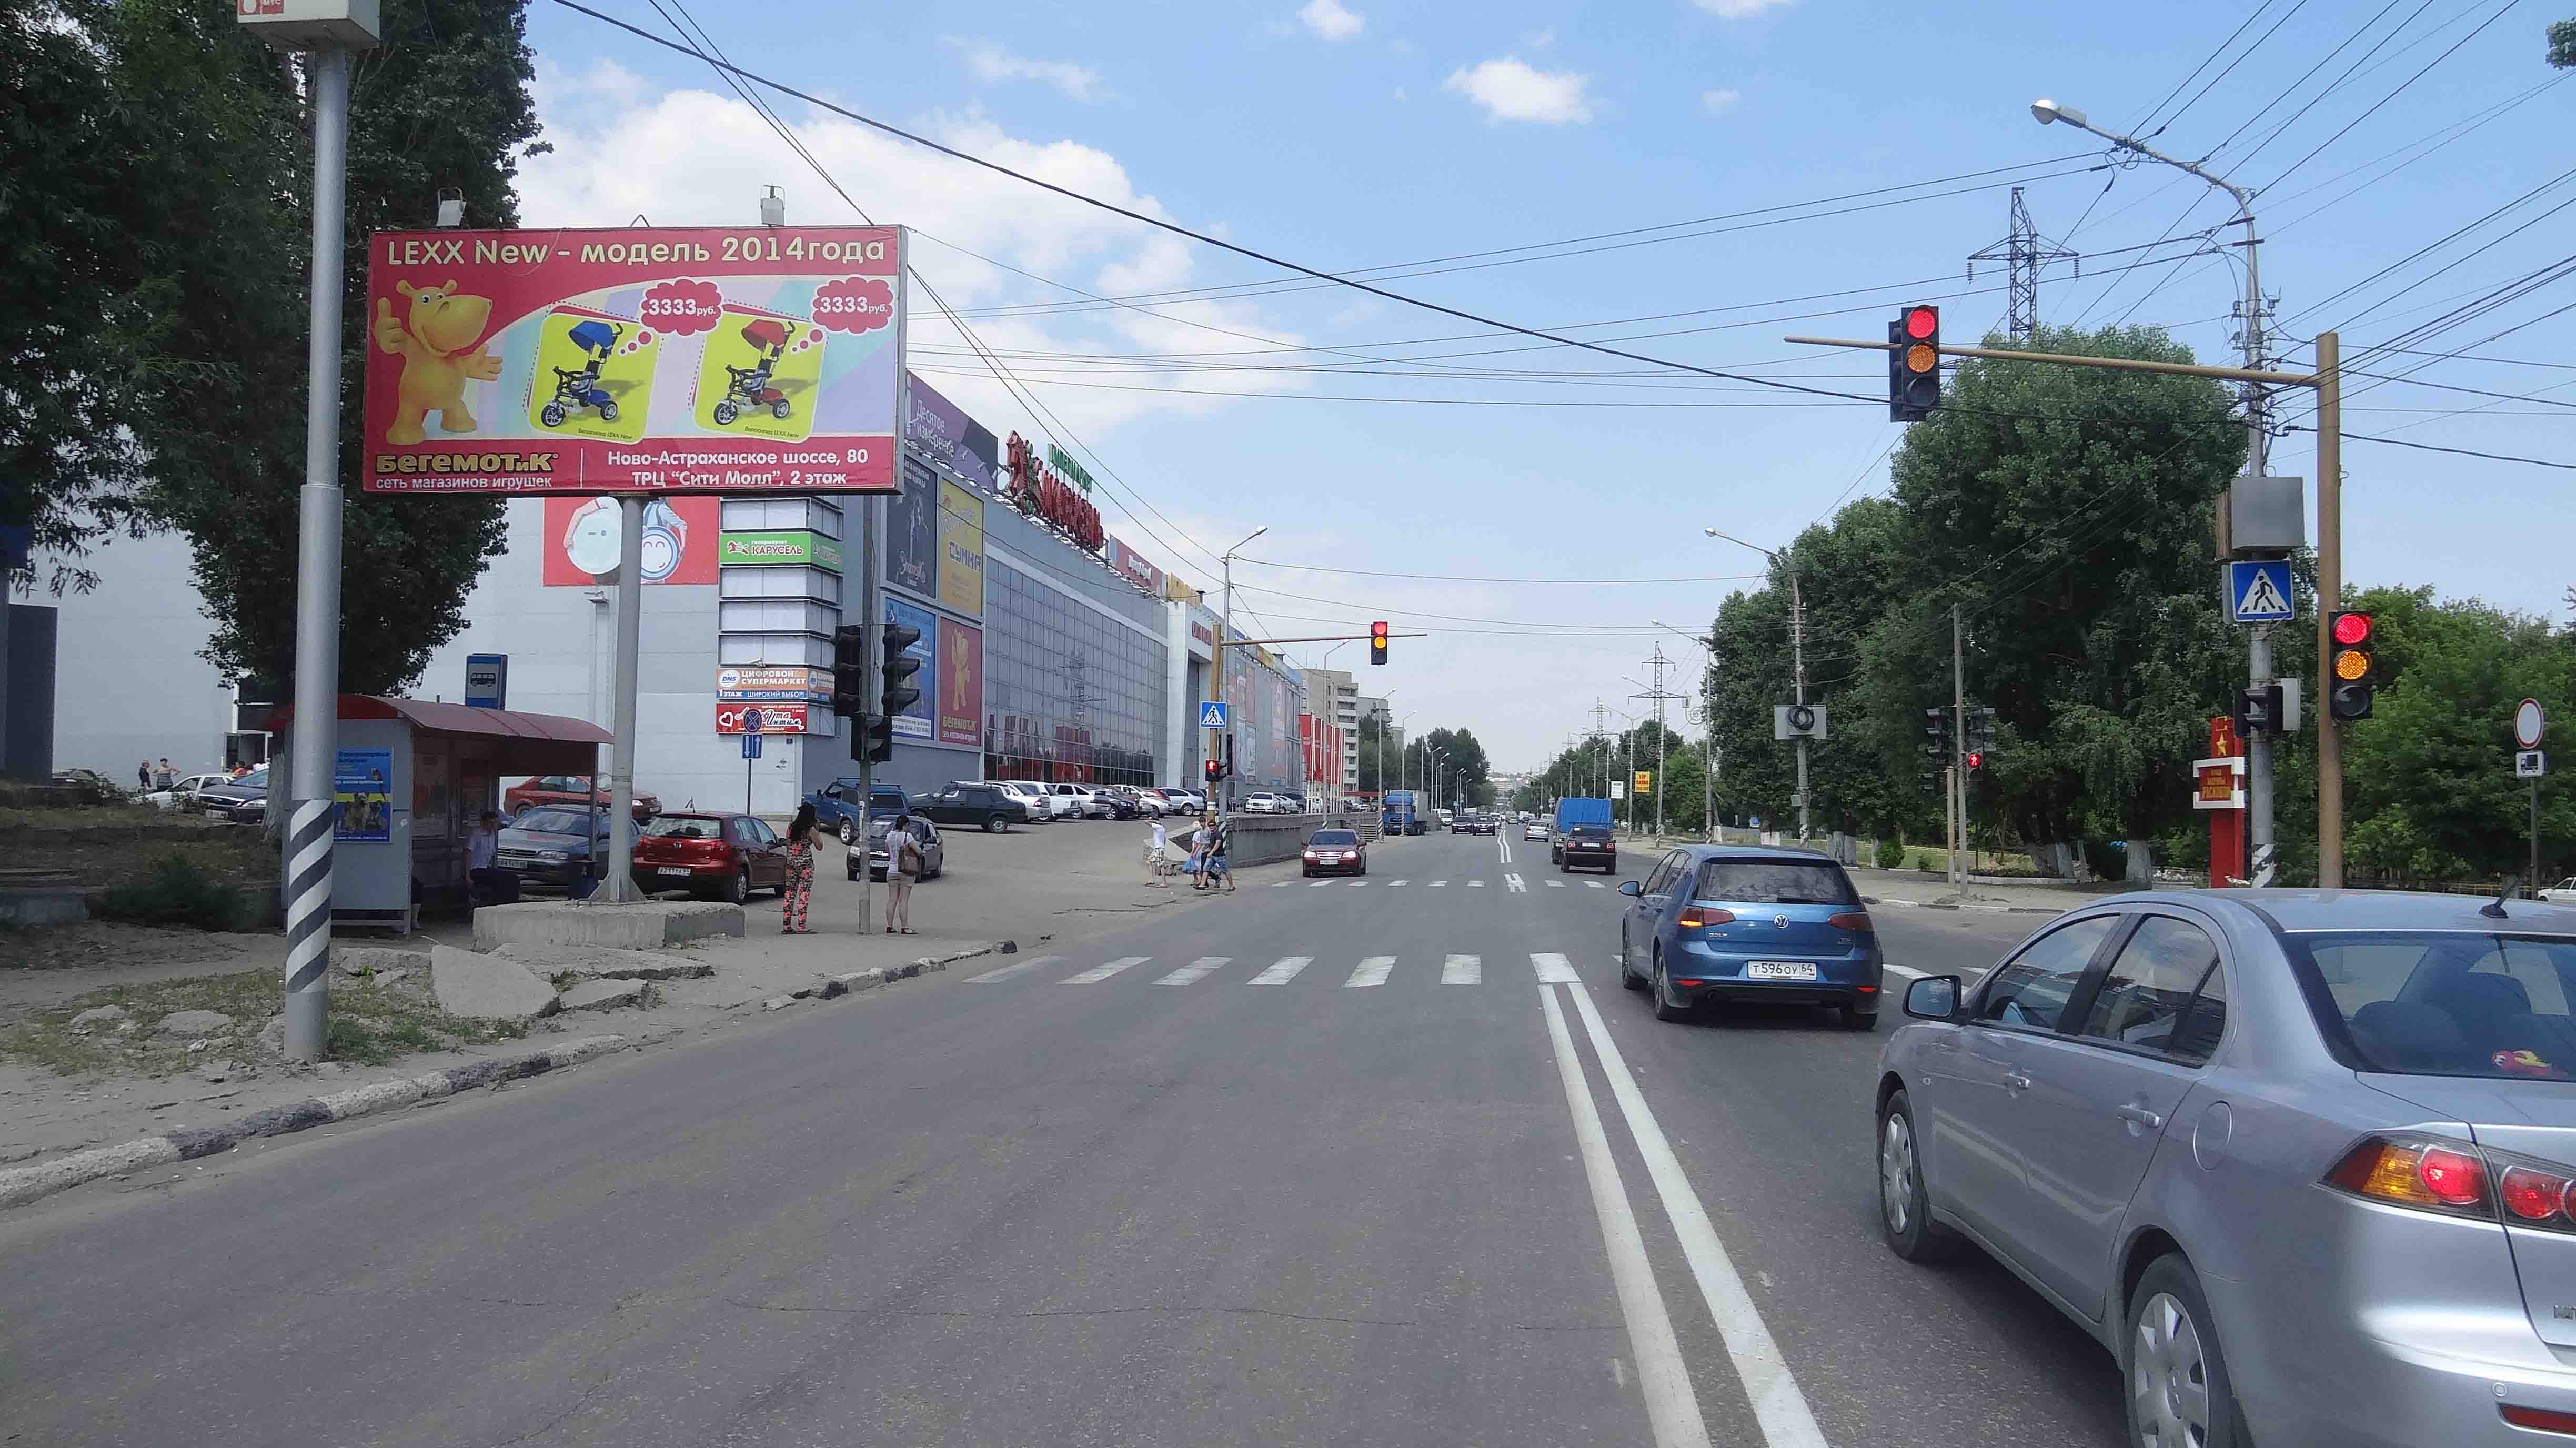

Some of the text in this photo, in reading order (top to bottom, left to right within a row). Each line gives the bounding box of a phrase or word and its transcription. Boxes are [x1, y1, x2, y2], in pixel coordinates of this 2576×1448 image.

[388, 240, 464, 265] LEXX
[475, 239, 548, 264] New
[580, 243, 710, 265] модель
[607, 449, 868, 467] Ново-Астраханское шоссе, 80
[376, 477, 552, 490] сеть магазинов игрушек
[631, 471, 665, 487] ТРЦ
[790, 471, 800, 485] 2
[804, 472, 847, 485] этаж
[751, 546, 804, 555] КАРУСЕЛЬ
[741, 669, 793, 678] ЦИФРОВОЙ
